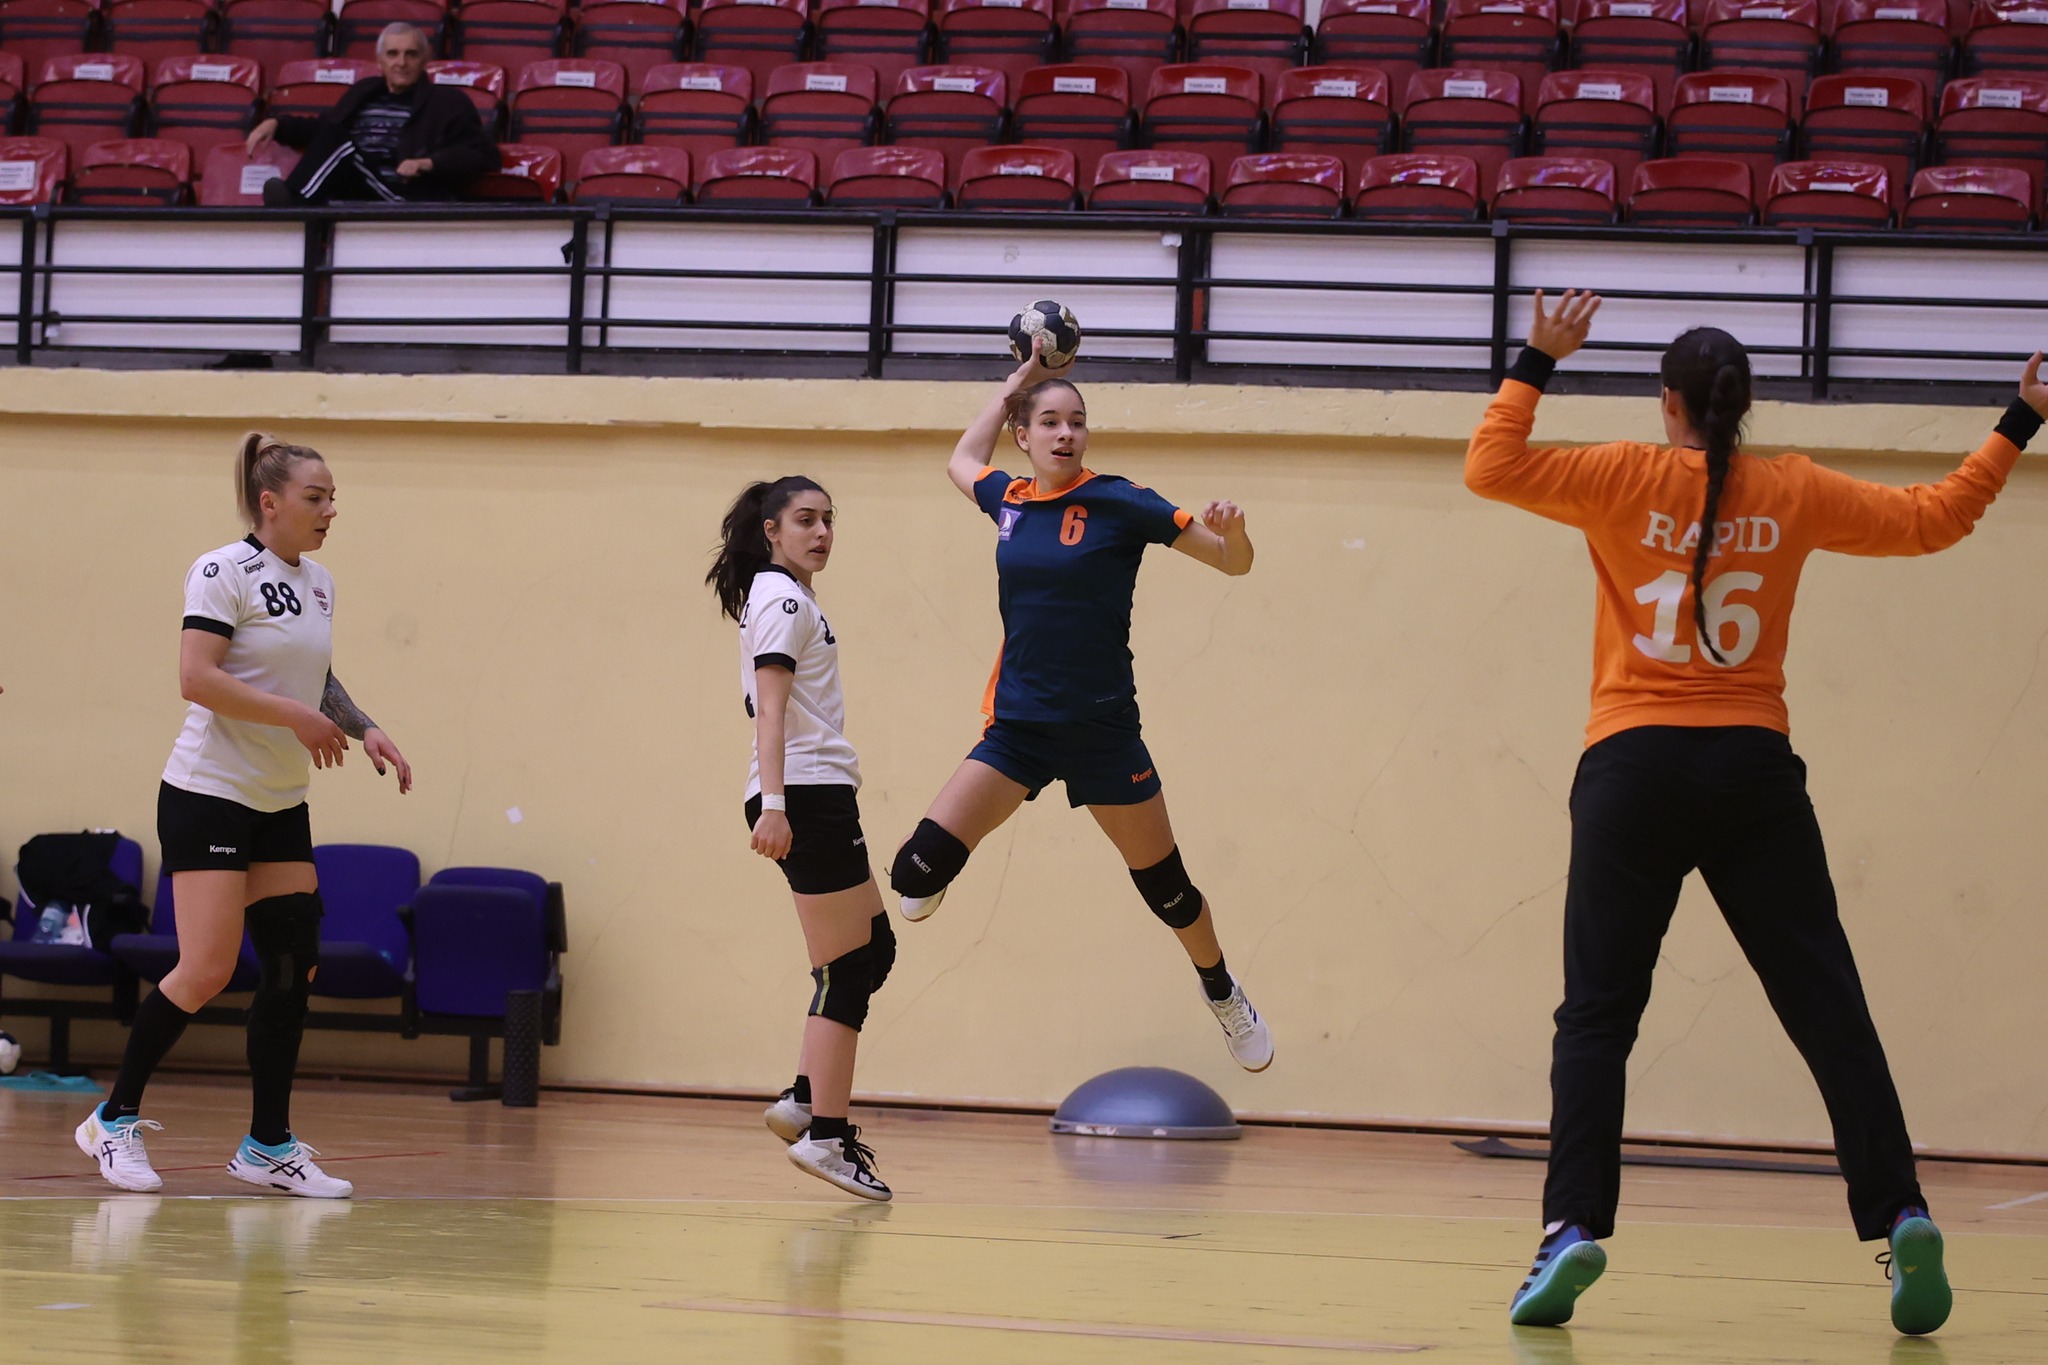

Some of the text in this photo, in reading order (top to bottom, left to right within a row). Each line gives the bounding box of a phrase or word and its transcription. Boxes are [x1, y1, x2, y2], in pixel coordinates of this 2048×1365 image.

[1059, 504, 1089, 546] 6
[1640, 510, 1780, 557] RAPID
[244, 560, 265, 575] Kempa
[260, 582, 302, 617] 88
[1632, 569, 1764, 668] 16
[209, 844, 237, 855] Kempa
[911, 853, 932, 874] SELECT
[1163, 891, 1184, 910] SELECT
